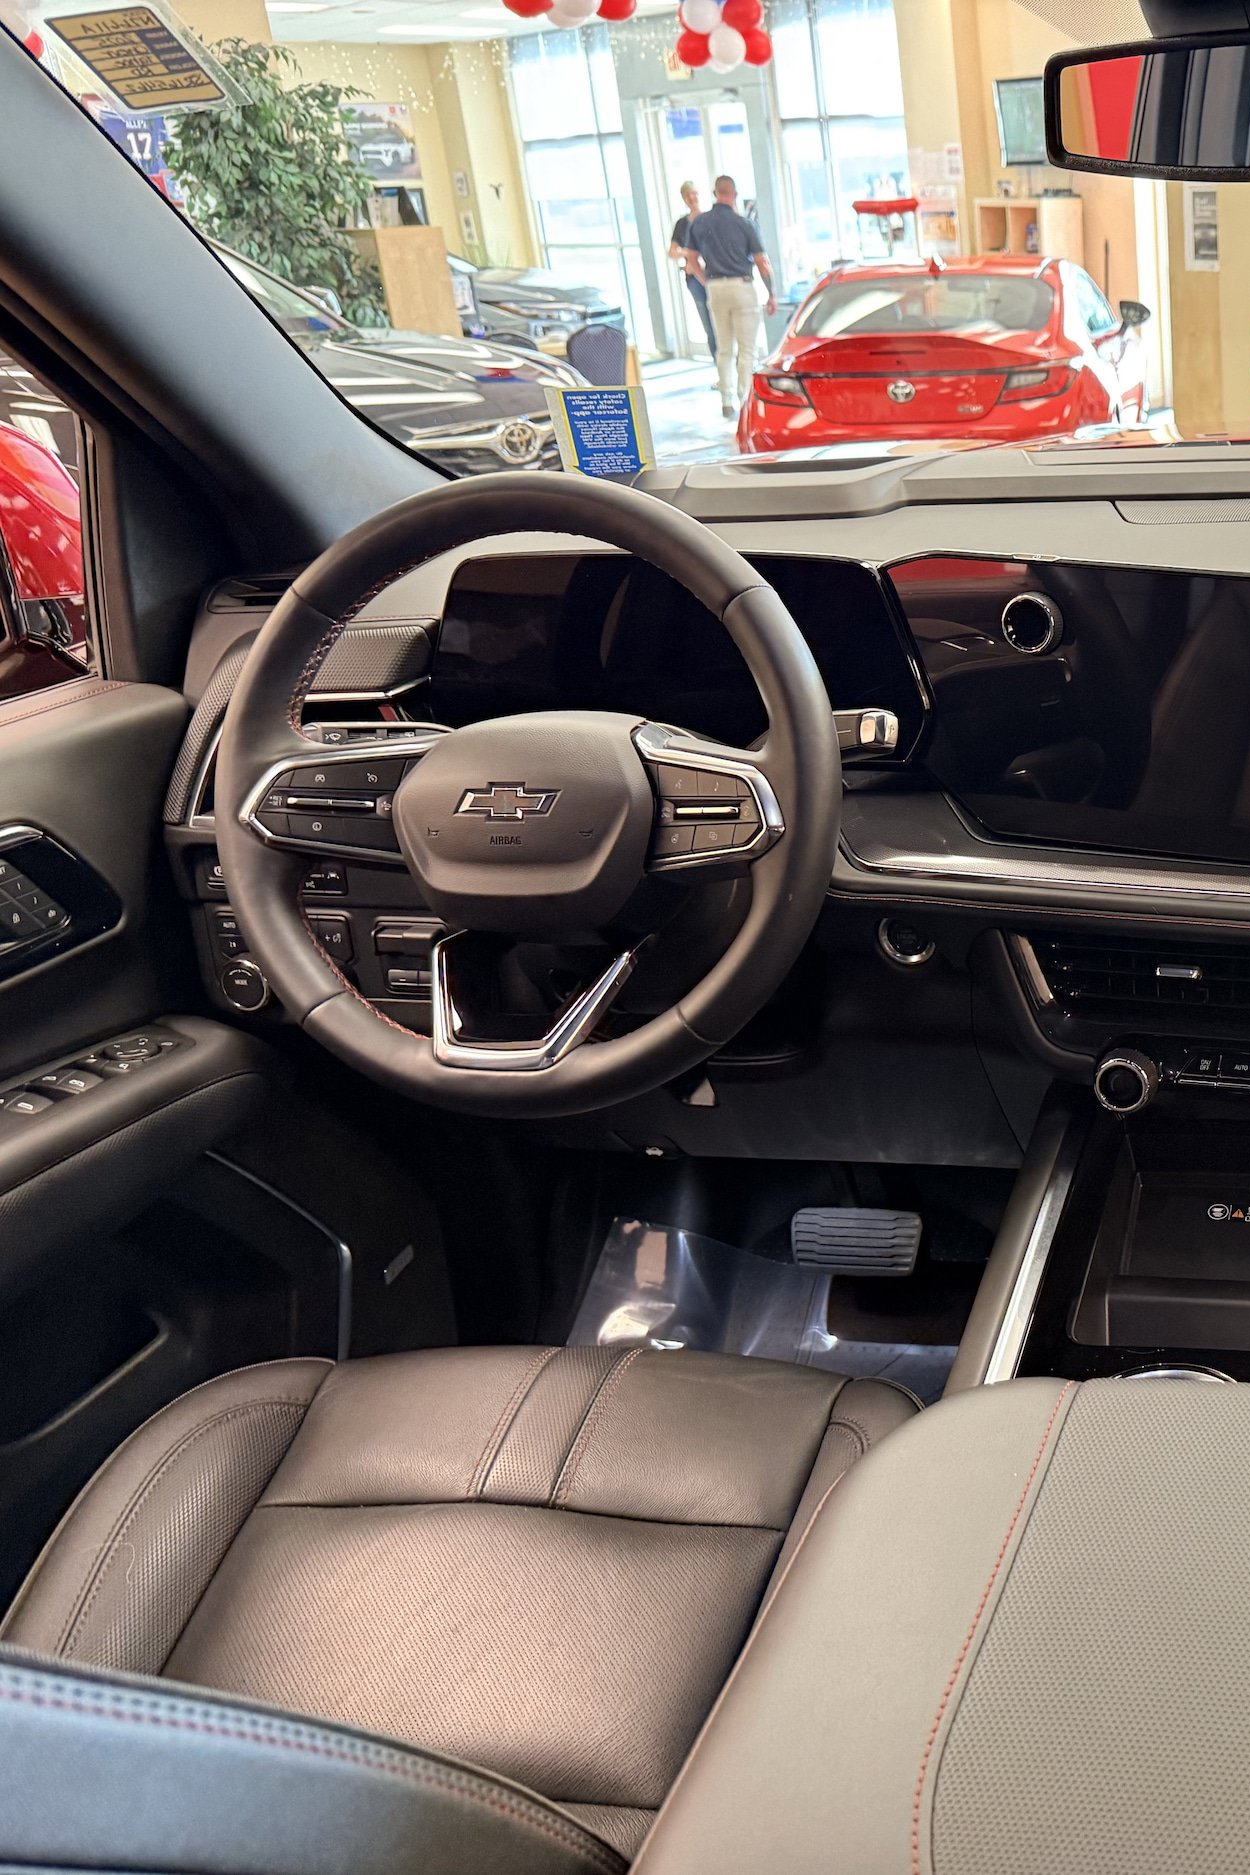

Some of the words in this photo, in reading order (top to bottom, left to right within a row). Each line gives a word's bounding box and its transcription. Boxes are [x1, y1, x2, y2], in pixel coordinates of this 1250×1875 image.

[127, 132, 152, 160] 17
[489, 836, 522, 845] AIRBAG
[1234, 1064, 1249, 1072] AUTO
